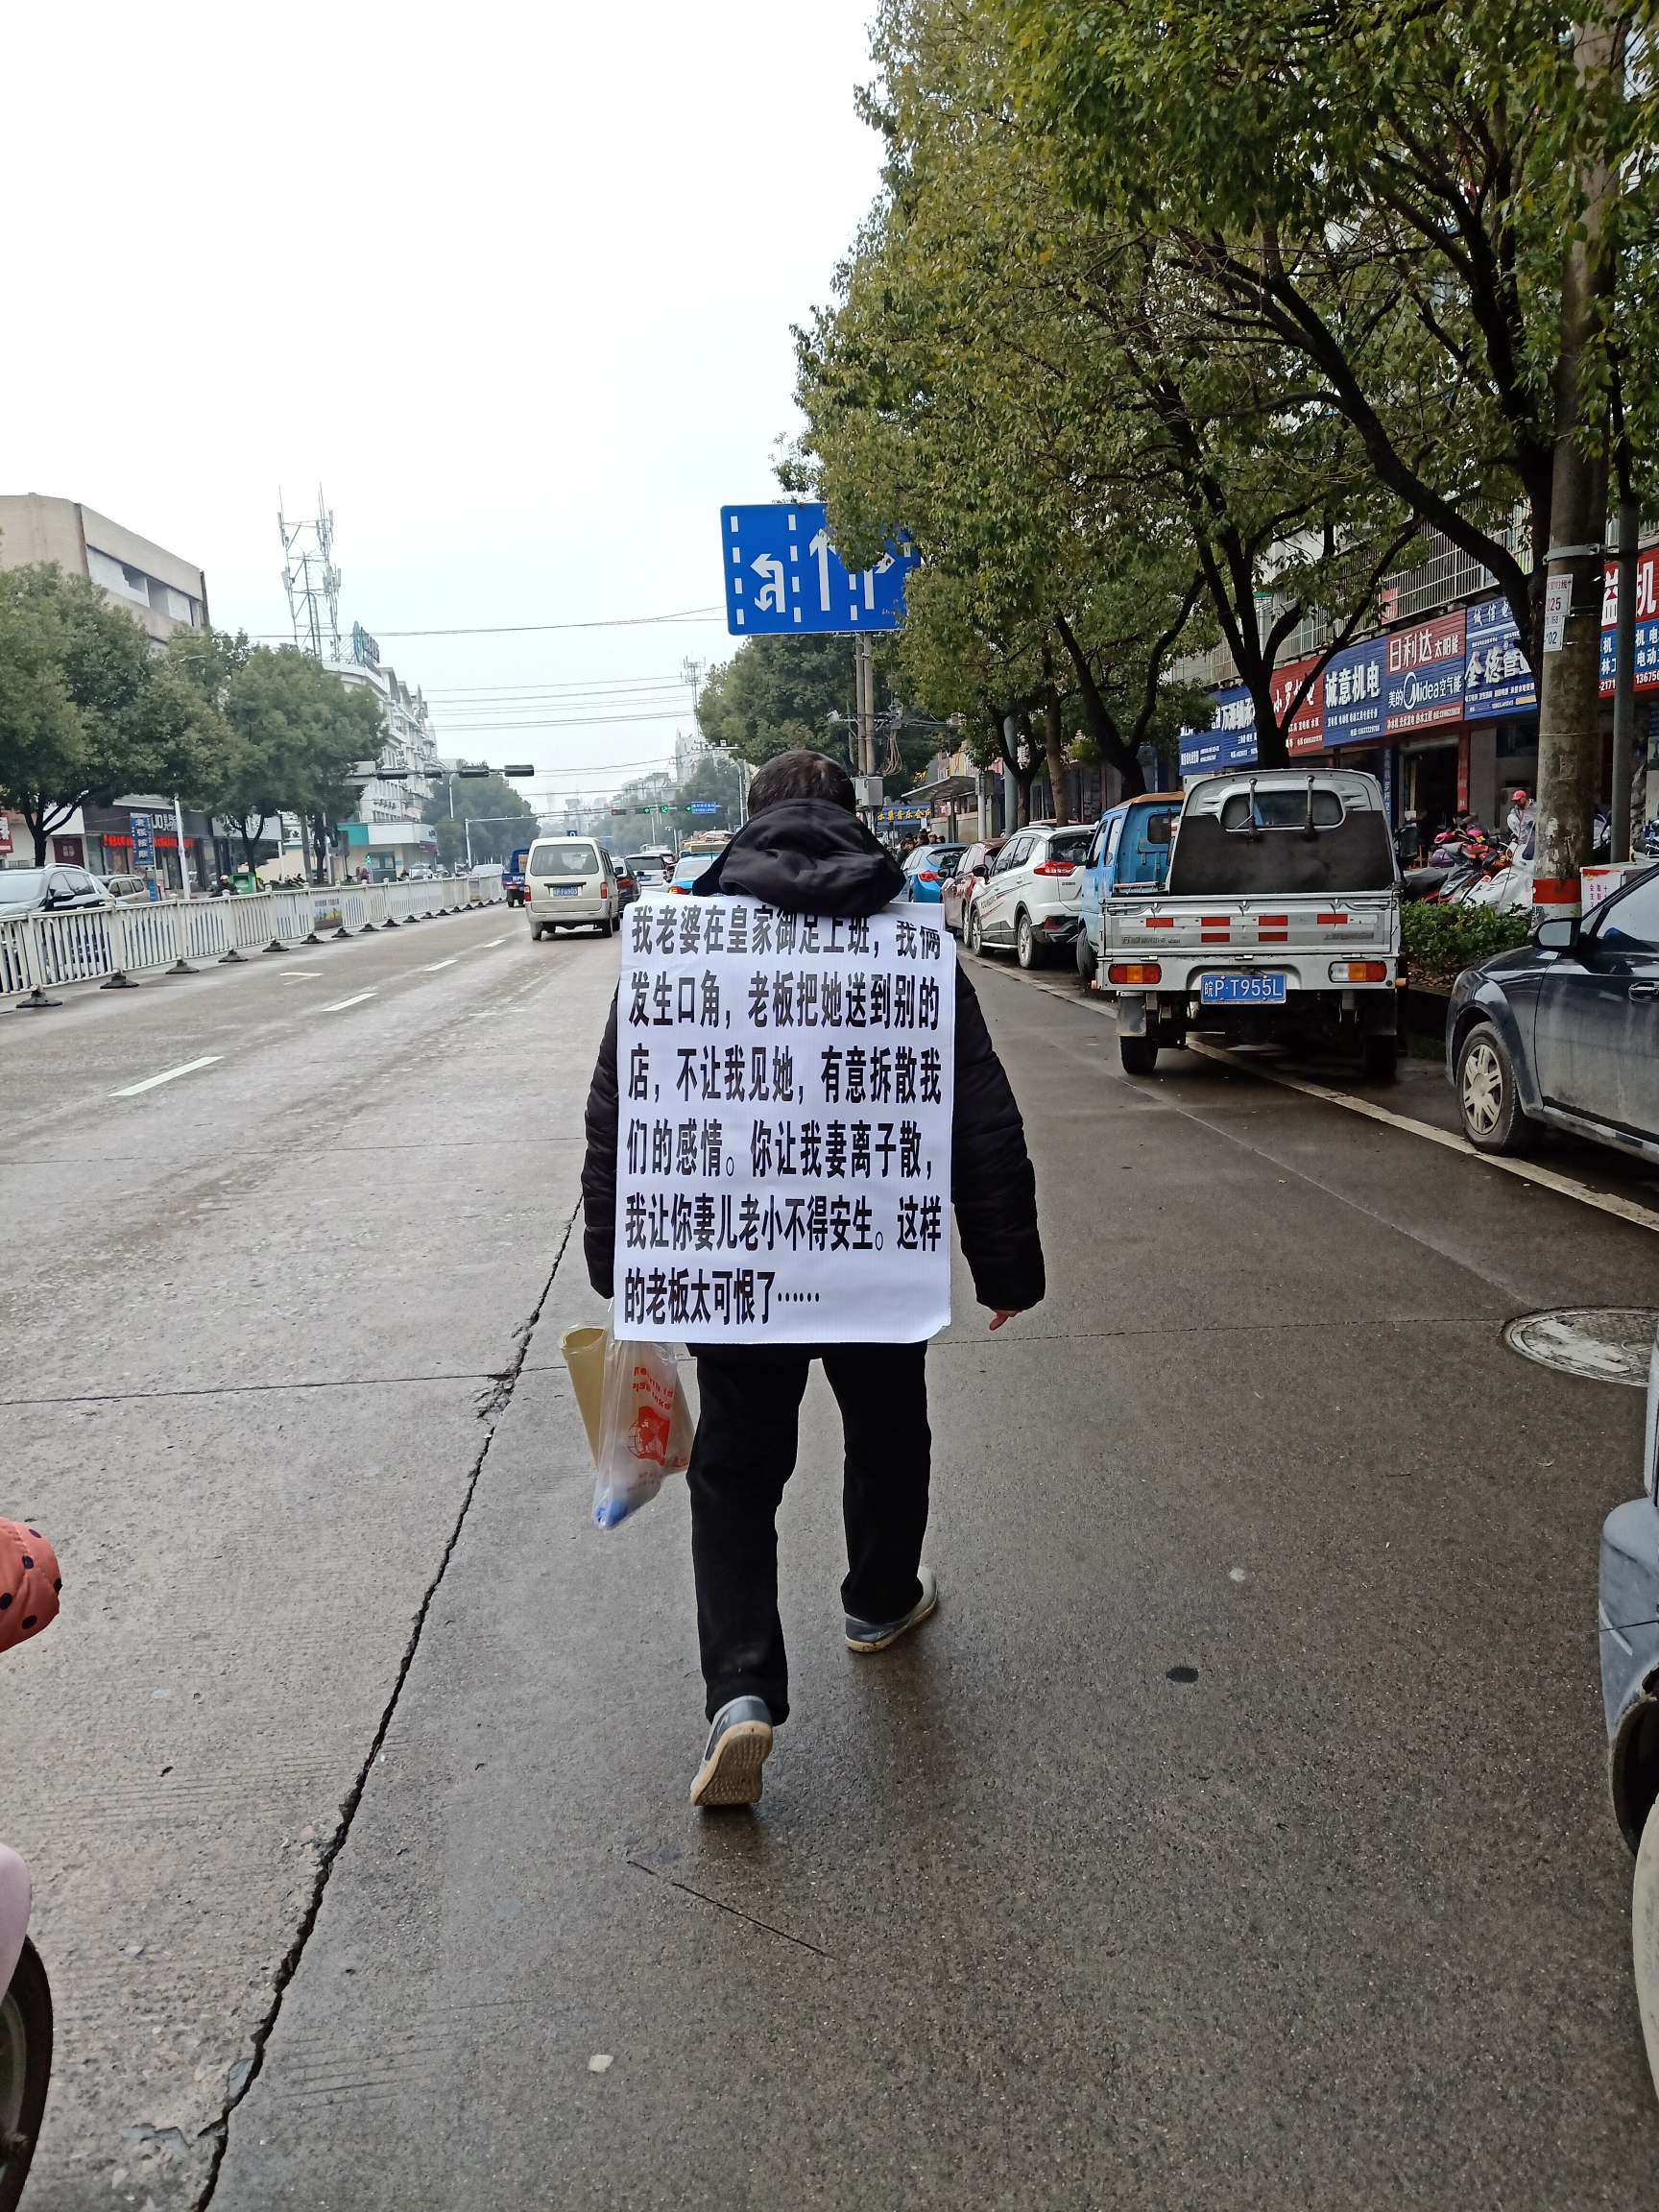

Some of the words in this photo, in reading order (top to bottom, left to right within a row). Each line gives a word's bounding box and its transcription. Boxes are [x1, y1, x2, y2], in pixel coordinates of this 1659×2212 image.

[1389, 629, 1432, 672] 日利达
[1434, 635, 1459, 658] 太阳能
[1325, 661, 1381, 708] 诚意机电
[1404, 671, 1439, 710] Midea
[1439, 674, 1462, 698] 空气能
[629, 969, 940, 1031] 发生口角，老板把她送到别的
[628, 1043, 942, 1105] 店，不让我见她，有意拆散我
[627, 1118, 933, 1181] 们的感情。你让我妻离子散，
[624, 1193, 942, 1253] 我让你妻儿老小不得安生。这样
